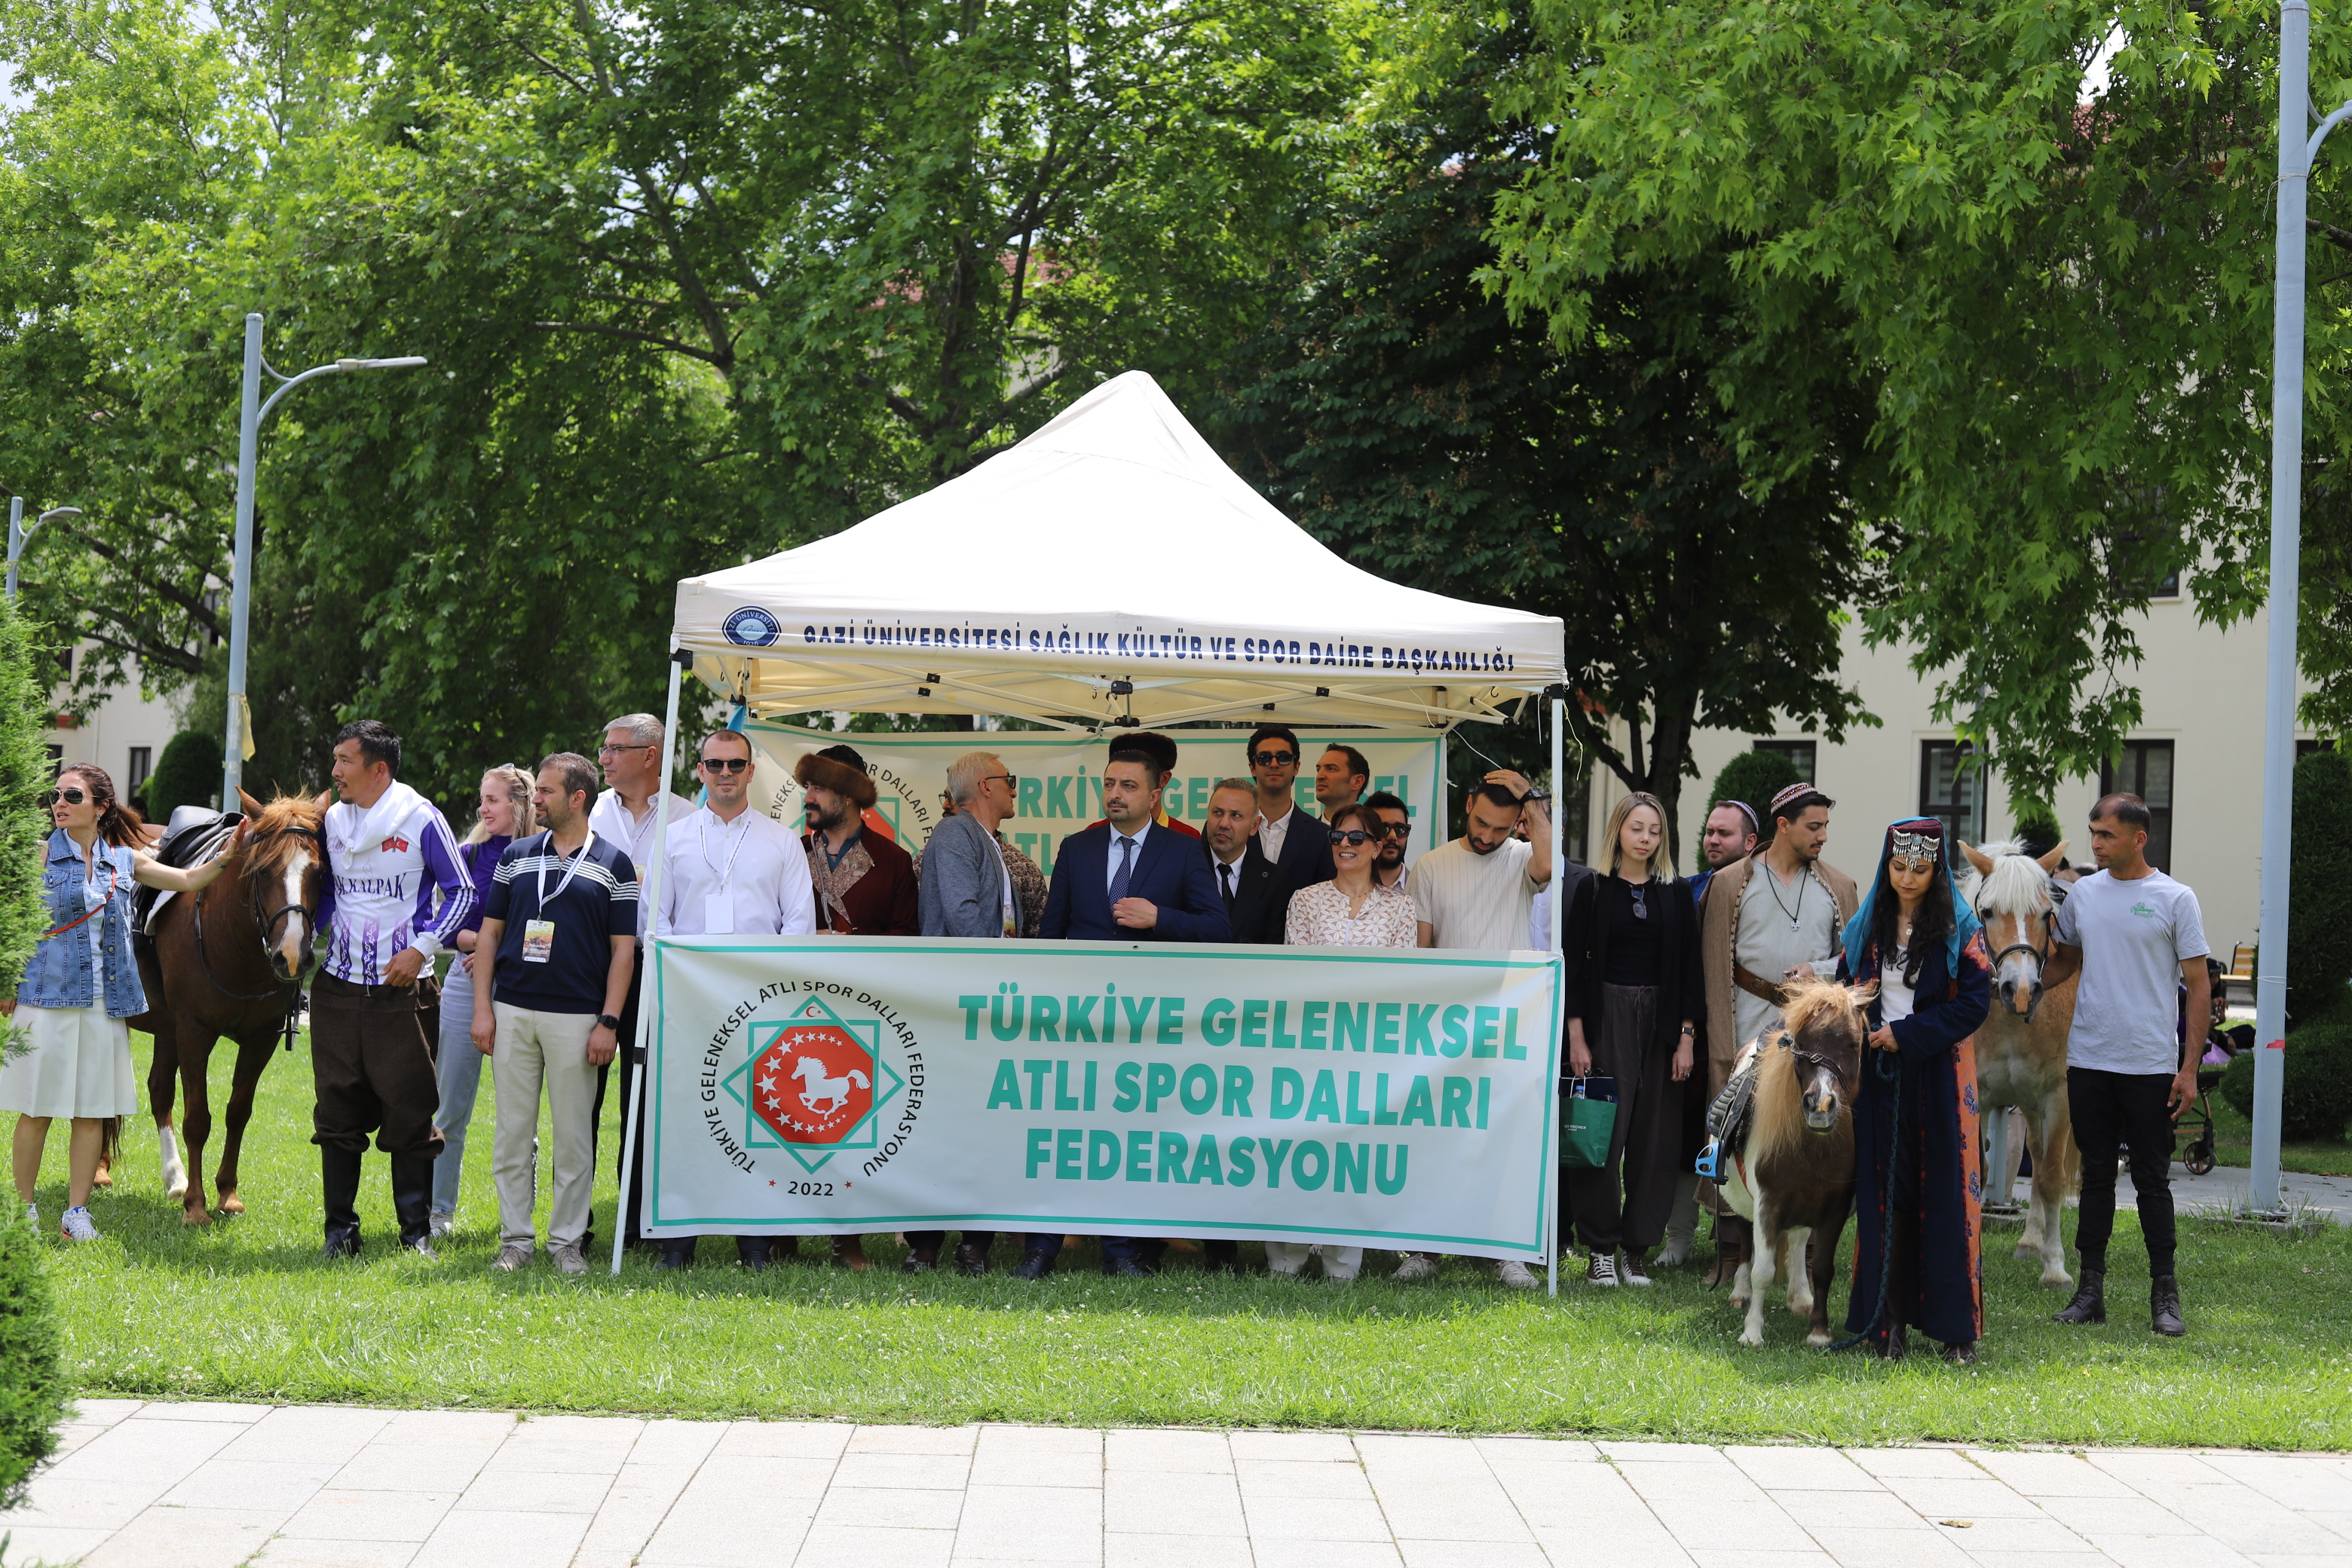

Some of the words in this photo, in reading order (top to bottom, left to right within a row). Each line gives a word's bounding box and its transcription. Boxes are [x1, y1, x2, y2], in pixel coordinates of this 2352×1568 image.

[804, 618, 854, 644] GAZİ
[864, 618, 1021, 651] ÜNİVERSİTESİ
[1030, 623, 1110, 656] SAĞLIK
[1117, 626, 1203, 660] KÜLTÜR
[1210, 637, 1236, 660] VE
[1244, 638, 1301, 664] SPOR
[1309, 635, 1374, 668] DAİRE
[1382, 645, 1514, 675] BAŞKANLIĞI
[880, 769, 929, 822] DALLARI
[348, 871, 407, 902] KALPAK
[758, 981, 797, 1003] ATLI
[802, 980, 853, 998] SPOR
[856, 991, 917, 1049] DALLARI
[958, 982, 1186, 1045] TÜRKİYE
[1200, 997, 1528, 1061] GELENEKSEL
[700, 1000, 758, 1102] GELENEKSEL
[862, 1052, 925, 1178] FEDERASYONU
[986, 1058, 1098, 1112] ATLI
[1112, 1061, 1254, 1118] SPOR
[1269, 1066, 1491, 1131] DALLARI
[704, 1106, 756, 1174] TÜRKİYE
[1025, 1128, 1409, 1196] FEDERASYONU
[787, 1181, 835, 1197] 2022
